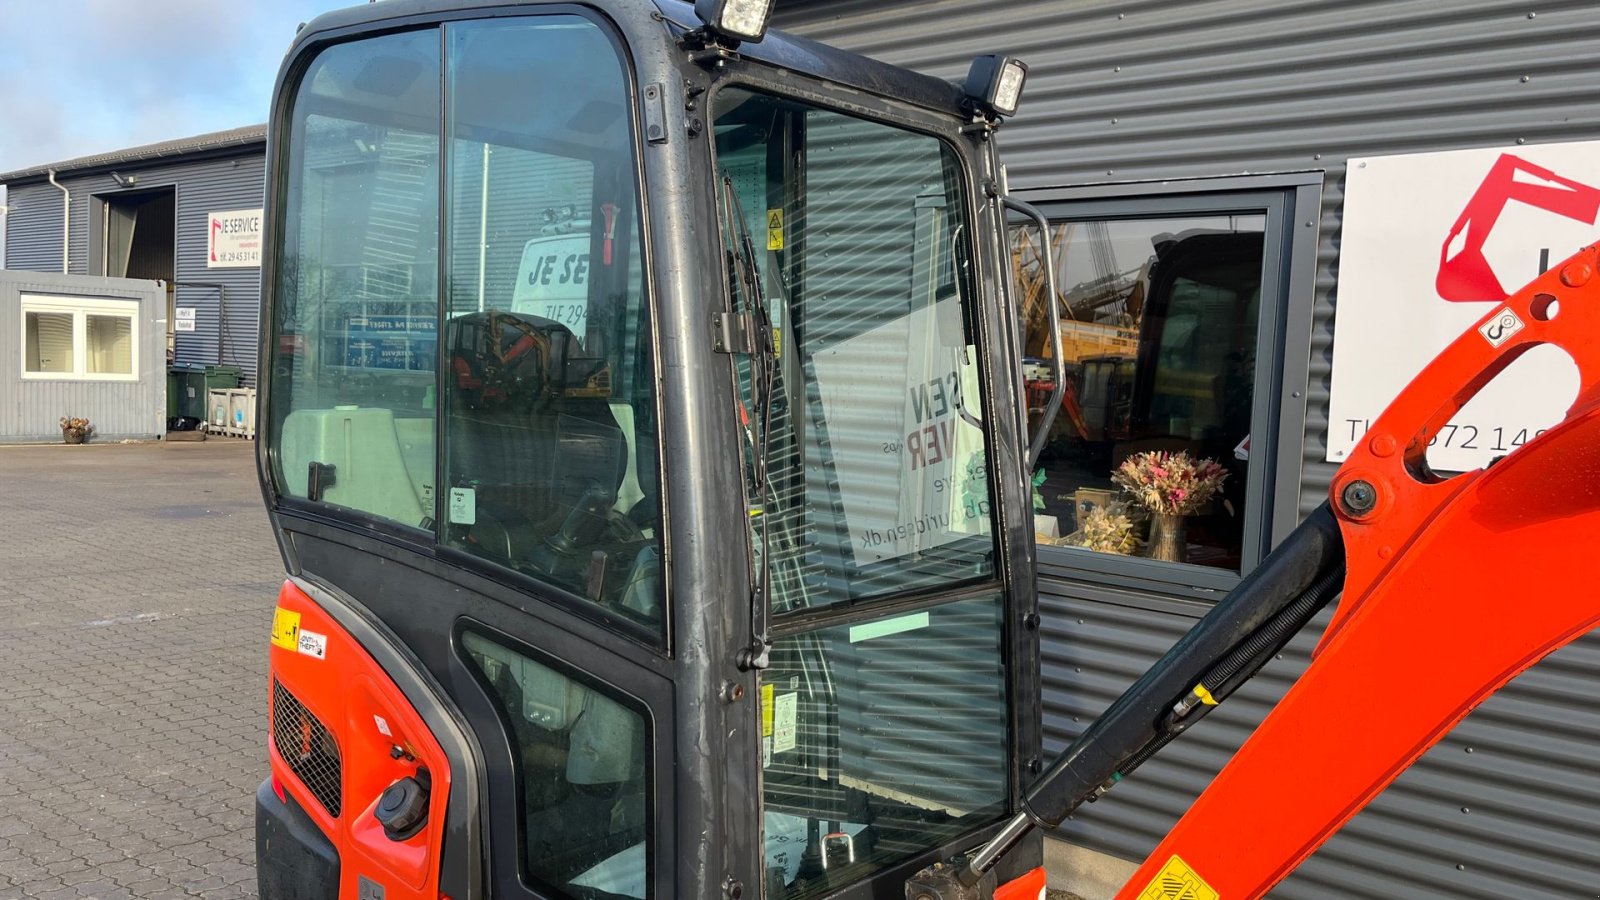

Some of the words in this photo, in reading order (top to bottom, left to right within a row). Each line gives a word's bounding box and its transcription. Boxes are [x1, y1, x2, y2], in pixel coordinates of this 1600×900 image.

[221, 219, 228, 233] JE
[230, 217, 258, 233] SERVICE
[229, 252, 235, 261] 29
[236, 252, 242, 261] 45
[244, 251, 250, 261] 31
[251, 251, 258, 261] 41
[529, 255, 557, 285] JE
